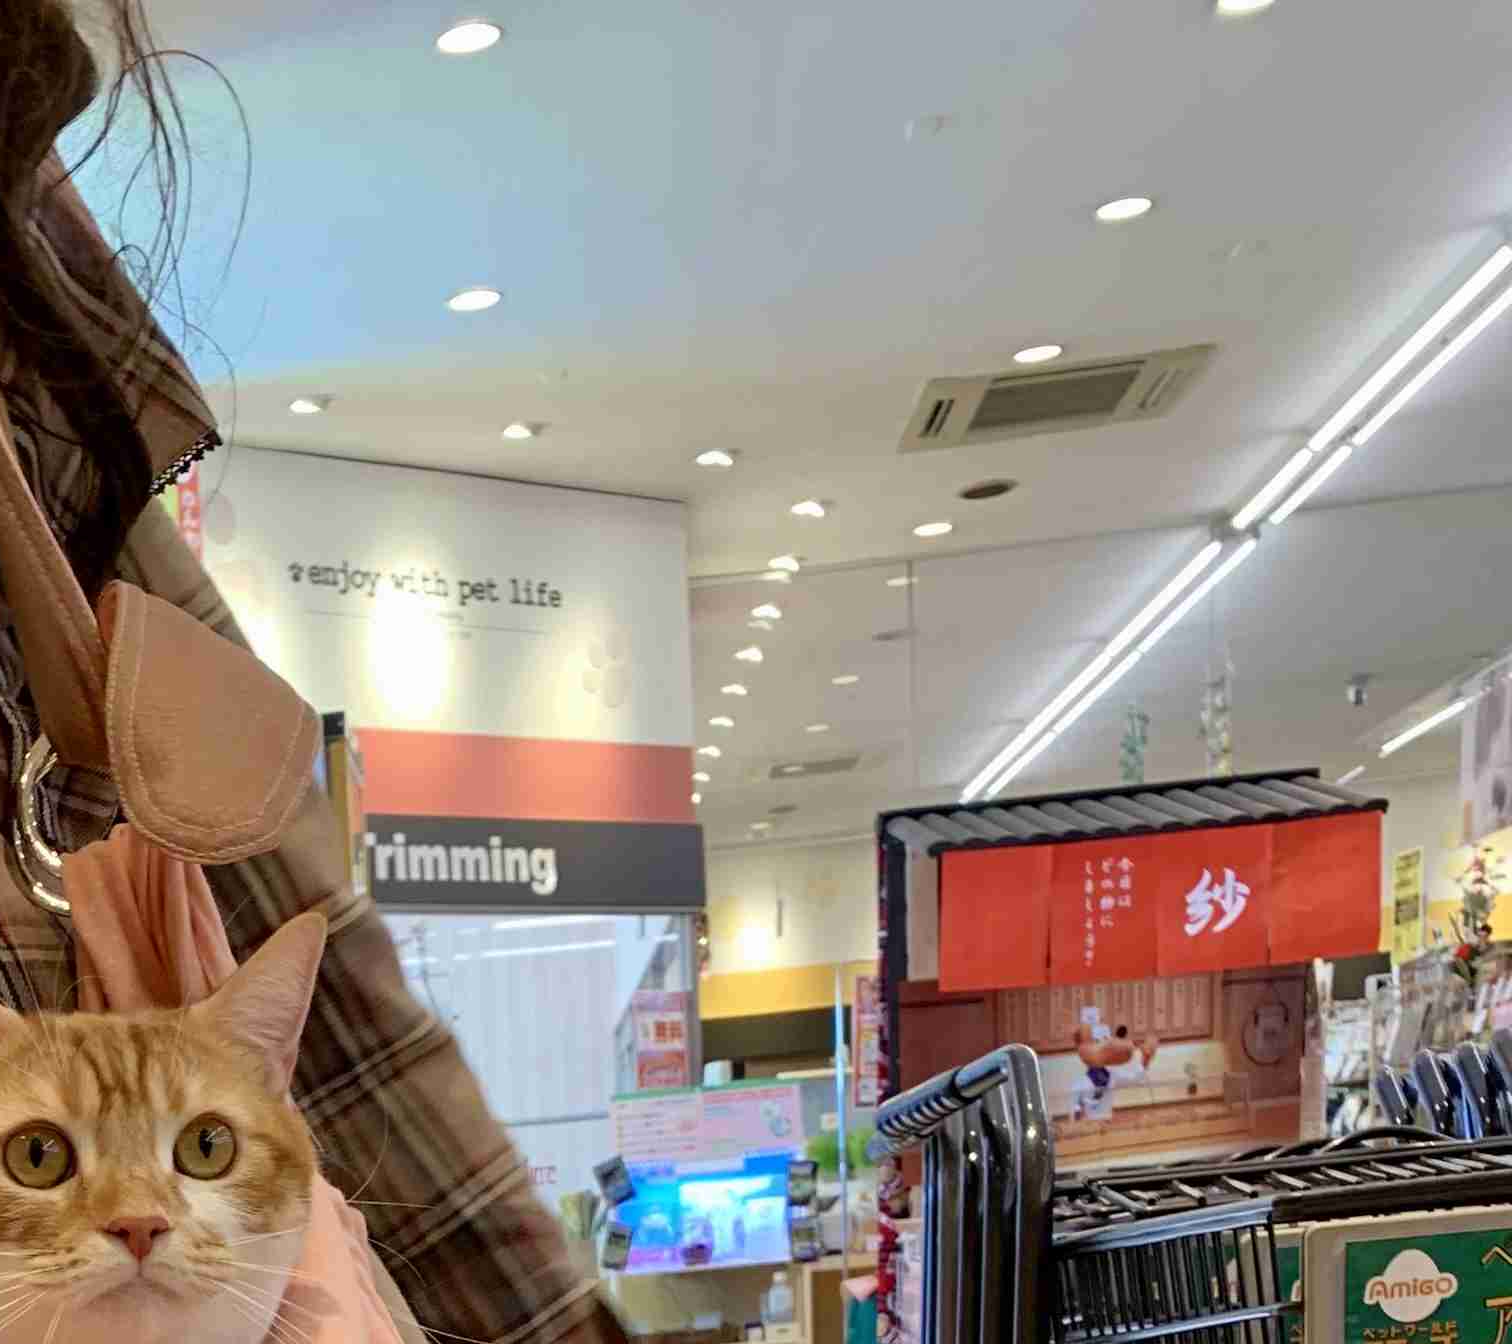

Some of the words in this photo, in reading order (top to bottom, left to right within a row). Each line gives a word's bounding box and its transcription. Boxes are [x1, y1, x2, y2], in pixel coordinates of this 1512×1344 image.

[307, 562, 380, 596] enjoy
[457, 578, 500, 607] pet
[509, 578, 563, 609] life
[364, 832, 558, 895] rimming
